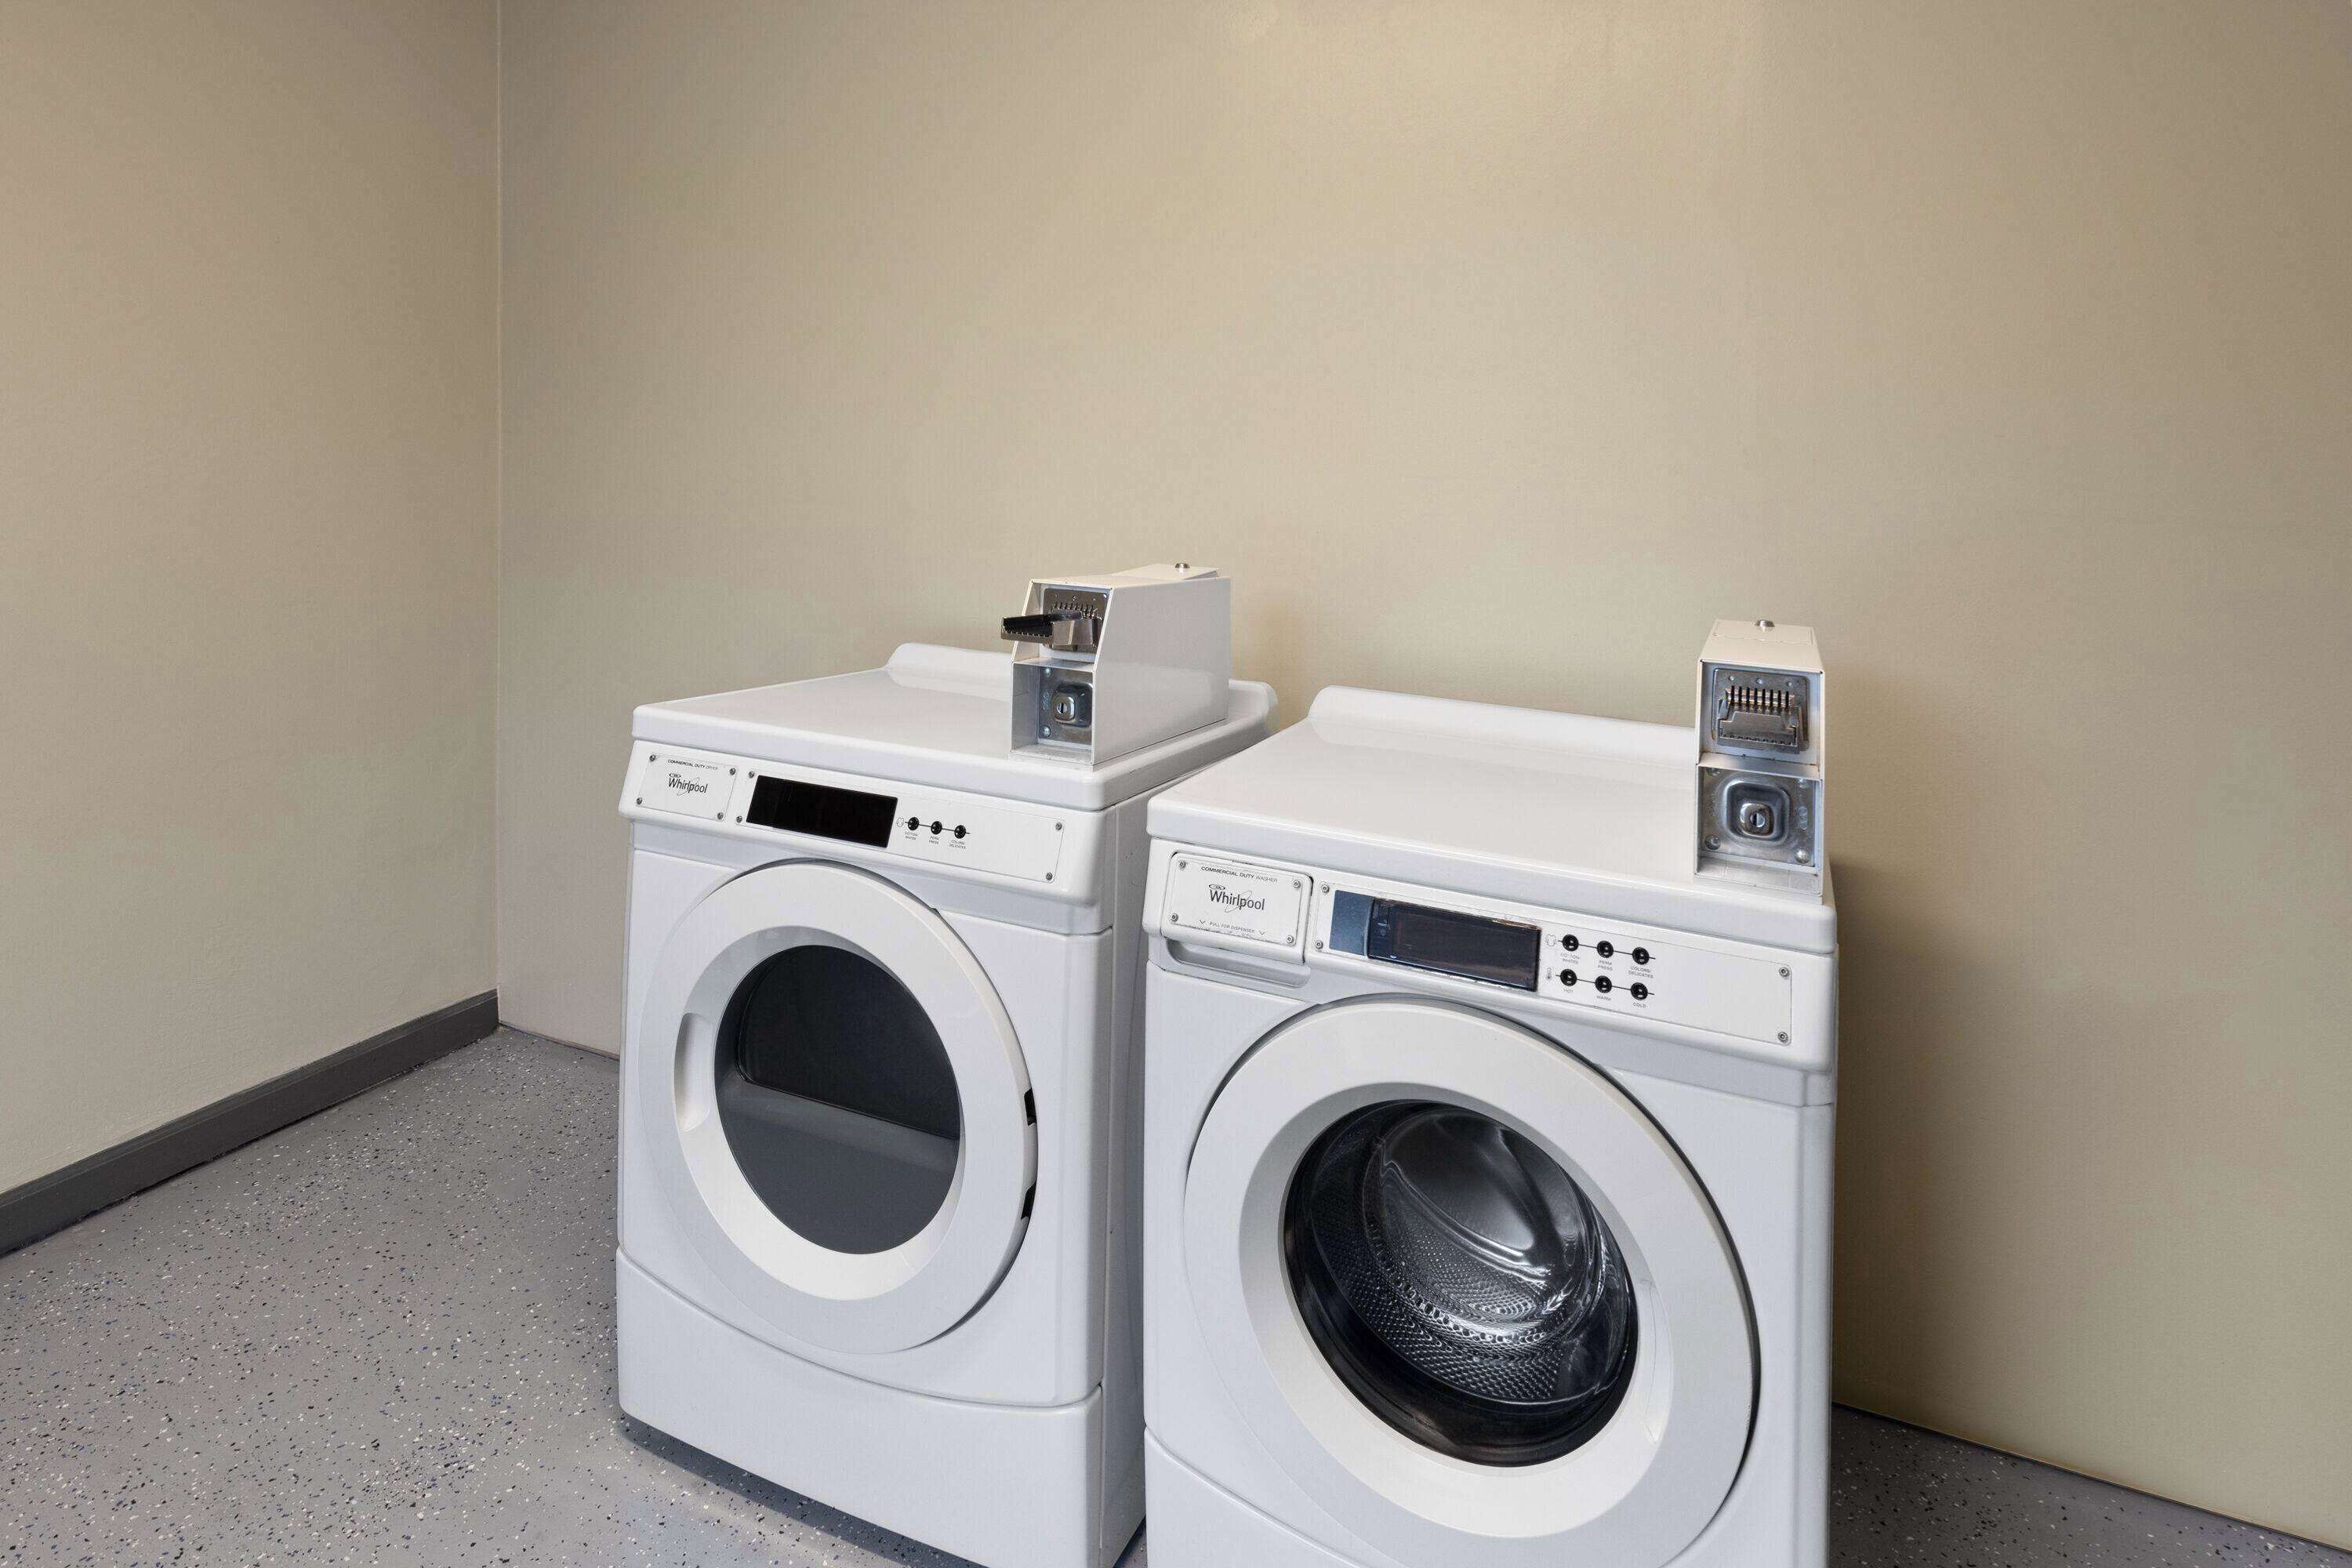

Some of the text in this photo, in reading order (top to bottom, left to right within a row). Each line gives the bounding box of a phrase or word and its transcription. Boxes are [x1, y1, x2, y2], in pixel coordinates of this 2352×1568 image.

[668, 778, 708, 793] Whirlpool
[1201, 866, 1238, 876] COMMERCIAL
[1210, 889, 1265, 910] Whirlpool
